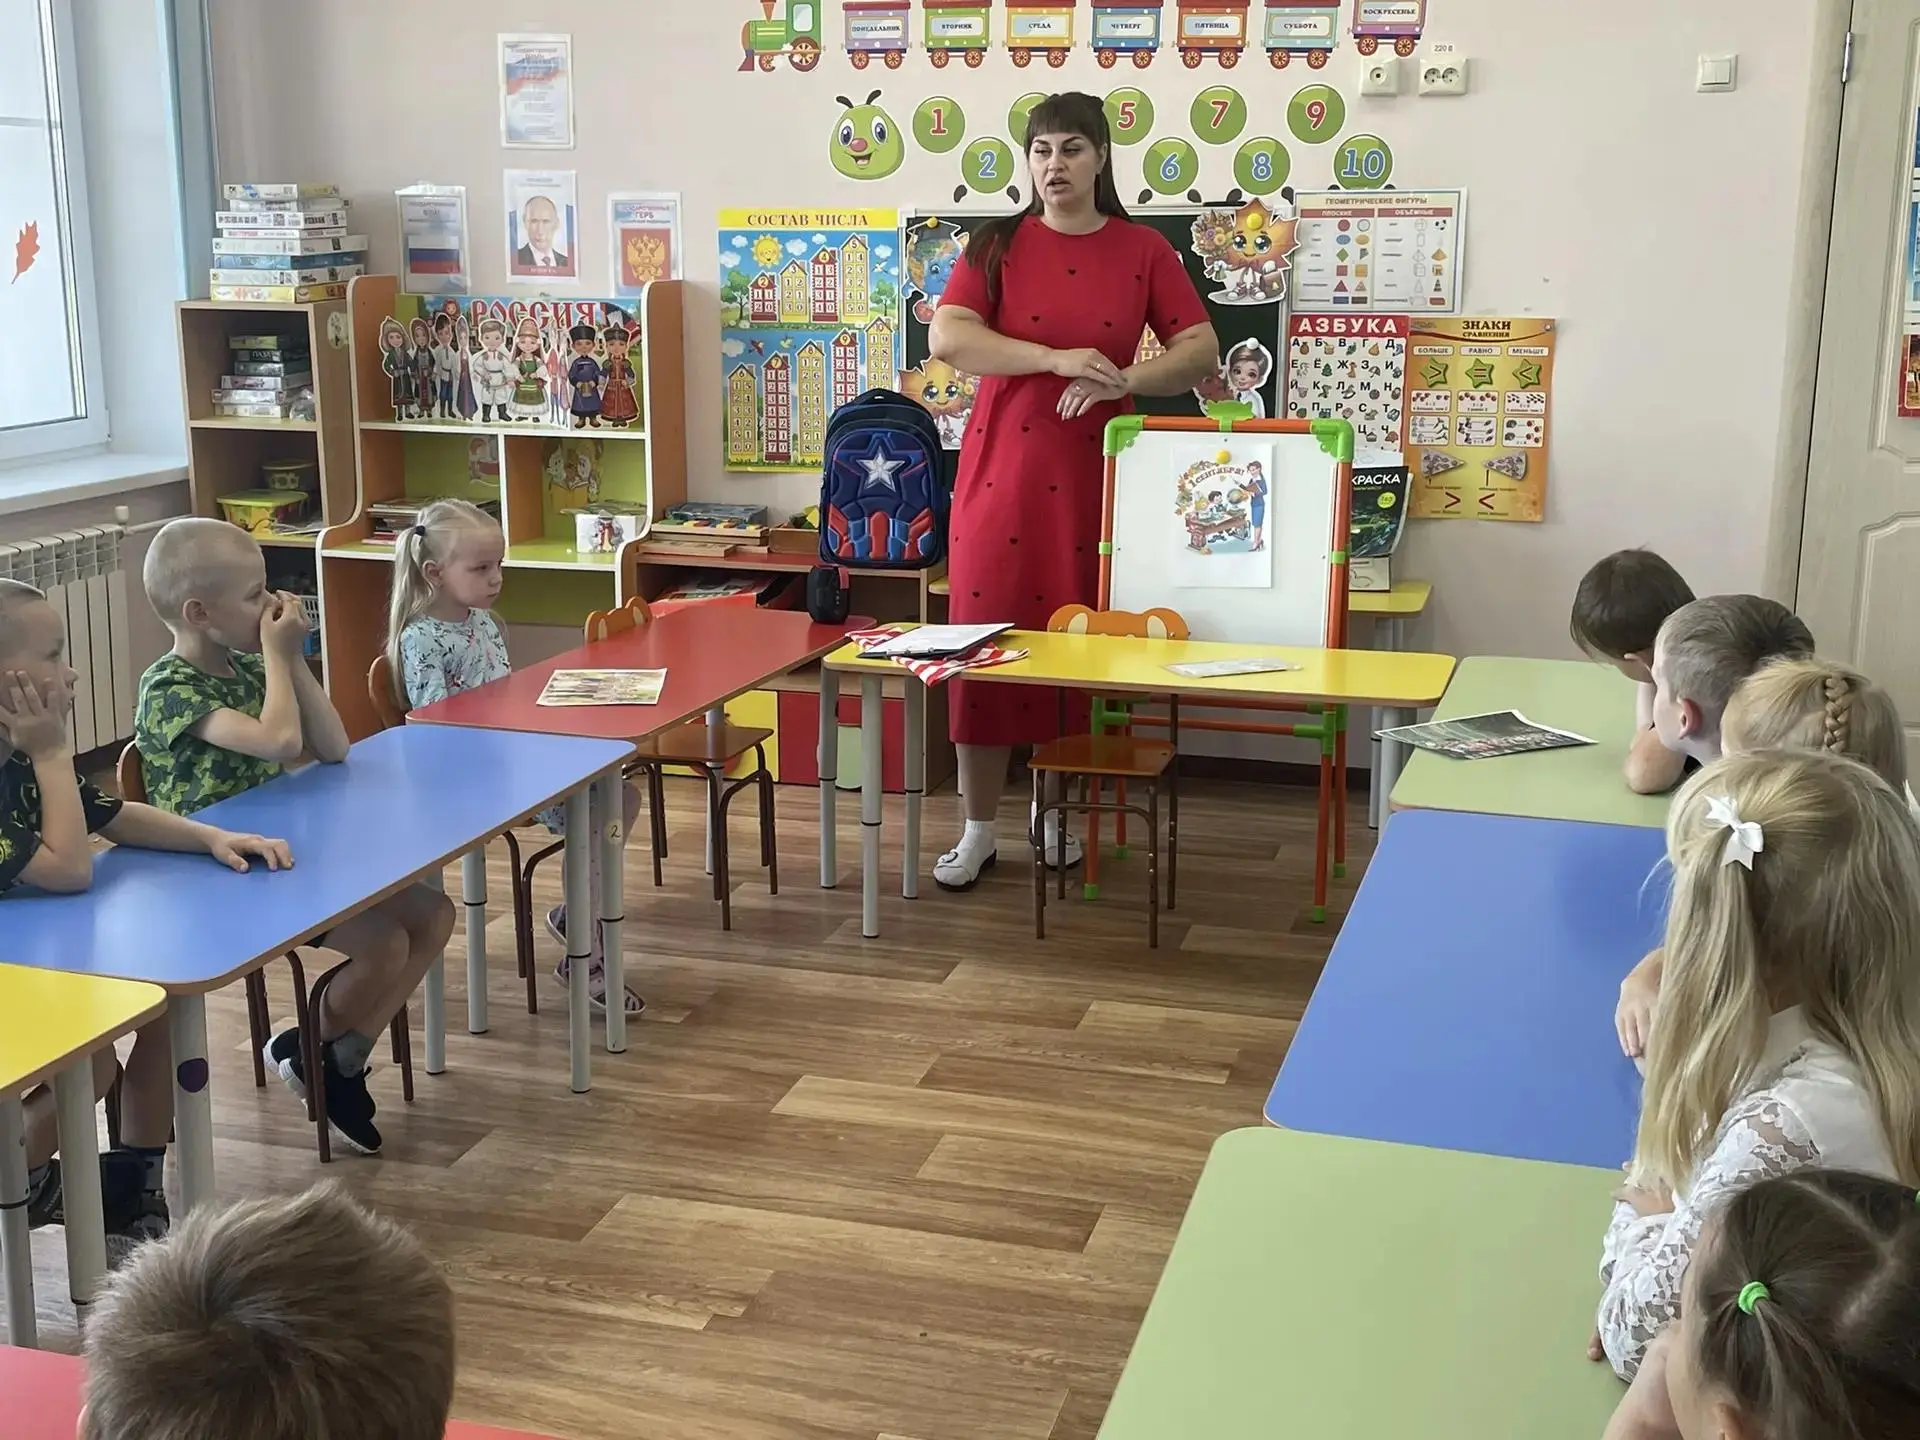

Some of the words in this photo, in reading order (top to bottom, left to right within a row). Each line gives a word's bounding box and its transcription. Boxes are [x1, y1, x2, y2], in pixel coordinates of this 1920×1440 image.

[931, 108, 948, 135] 1
[1118, 101, 1136, 129] 5
[1210, 100, 1229, 128] 7
[1306, 100, 1326, 130] 9
[978, 150, 996, 178] 2
[1160, 152, 1180, 181] 6
[1252, 152, 1272, 180] 8
[1342, 148, 1385, 178] 10
[747, 214, 809, 226] СОСТАВ
[815, 214, 868, 226] ЧИСЛА
[1298, 318, 1397, 333] АЗБУКА
[1462, 321, 1511, 330] ЗНАКИ
[1315, 338, 1322, 347] Б
[1385, 339, 1395, 349] Д
[1314, 359, 1321, 368] Ё
[1337, 360, 1348, 369] Ж
[1290, 380, 1298, 389] Й
[1313, 381, 1320, 389] К
[1360, 382, 1370, 390] М
[1384, 383, 1392, 391] Н
[1289, 402, 1298, 410] О
[1336, 403, 1343, 411] Р
[1359, 403, 1366, 412] С
[1383, 404, 1390, 412] Т
[1358, 425, 1366, 435] Ц
[1381, 425, 1388, 434] Ч
[611, 825, 620, 838] 2
